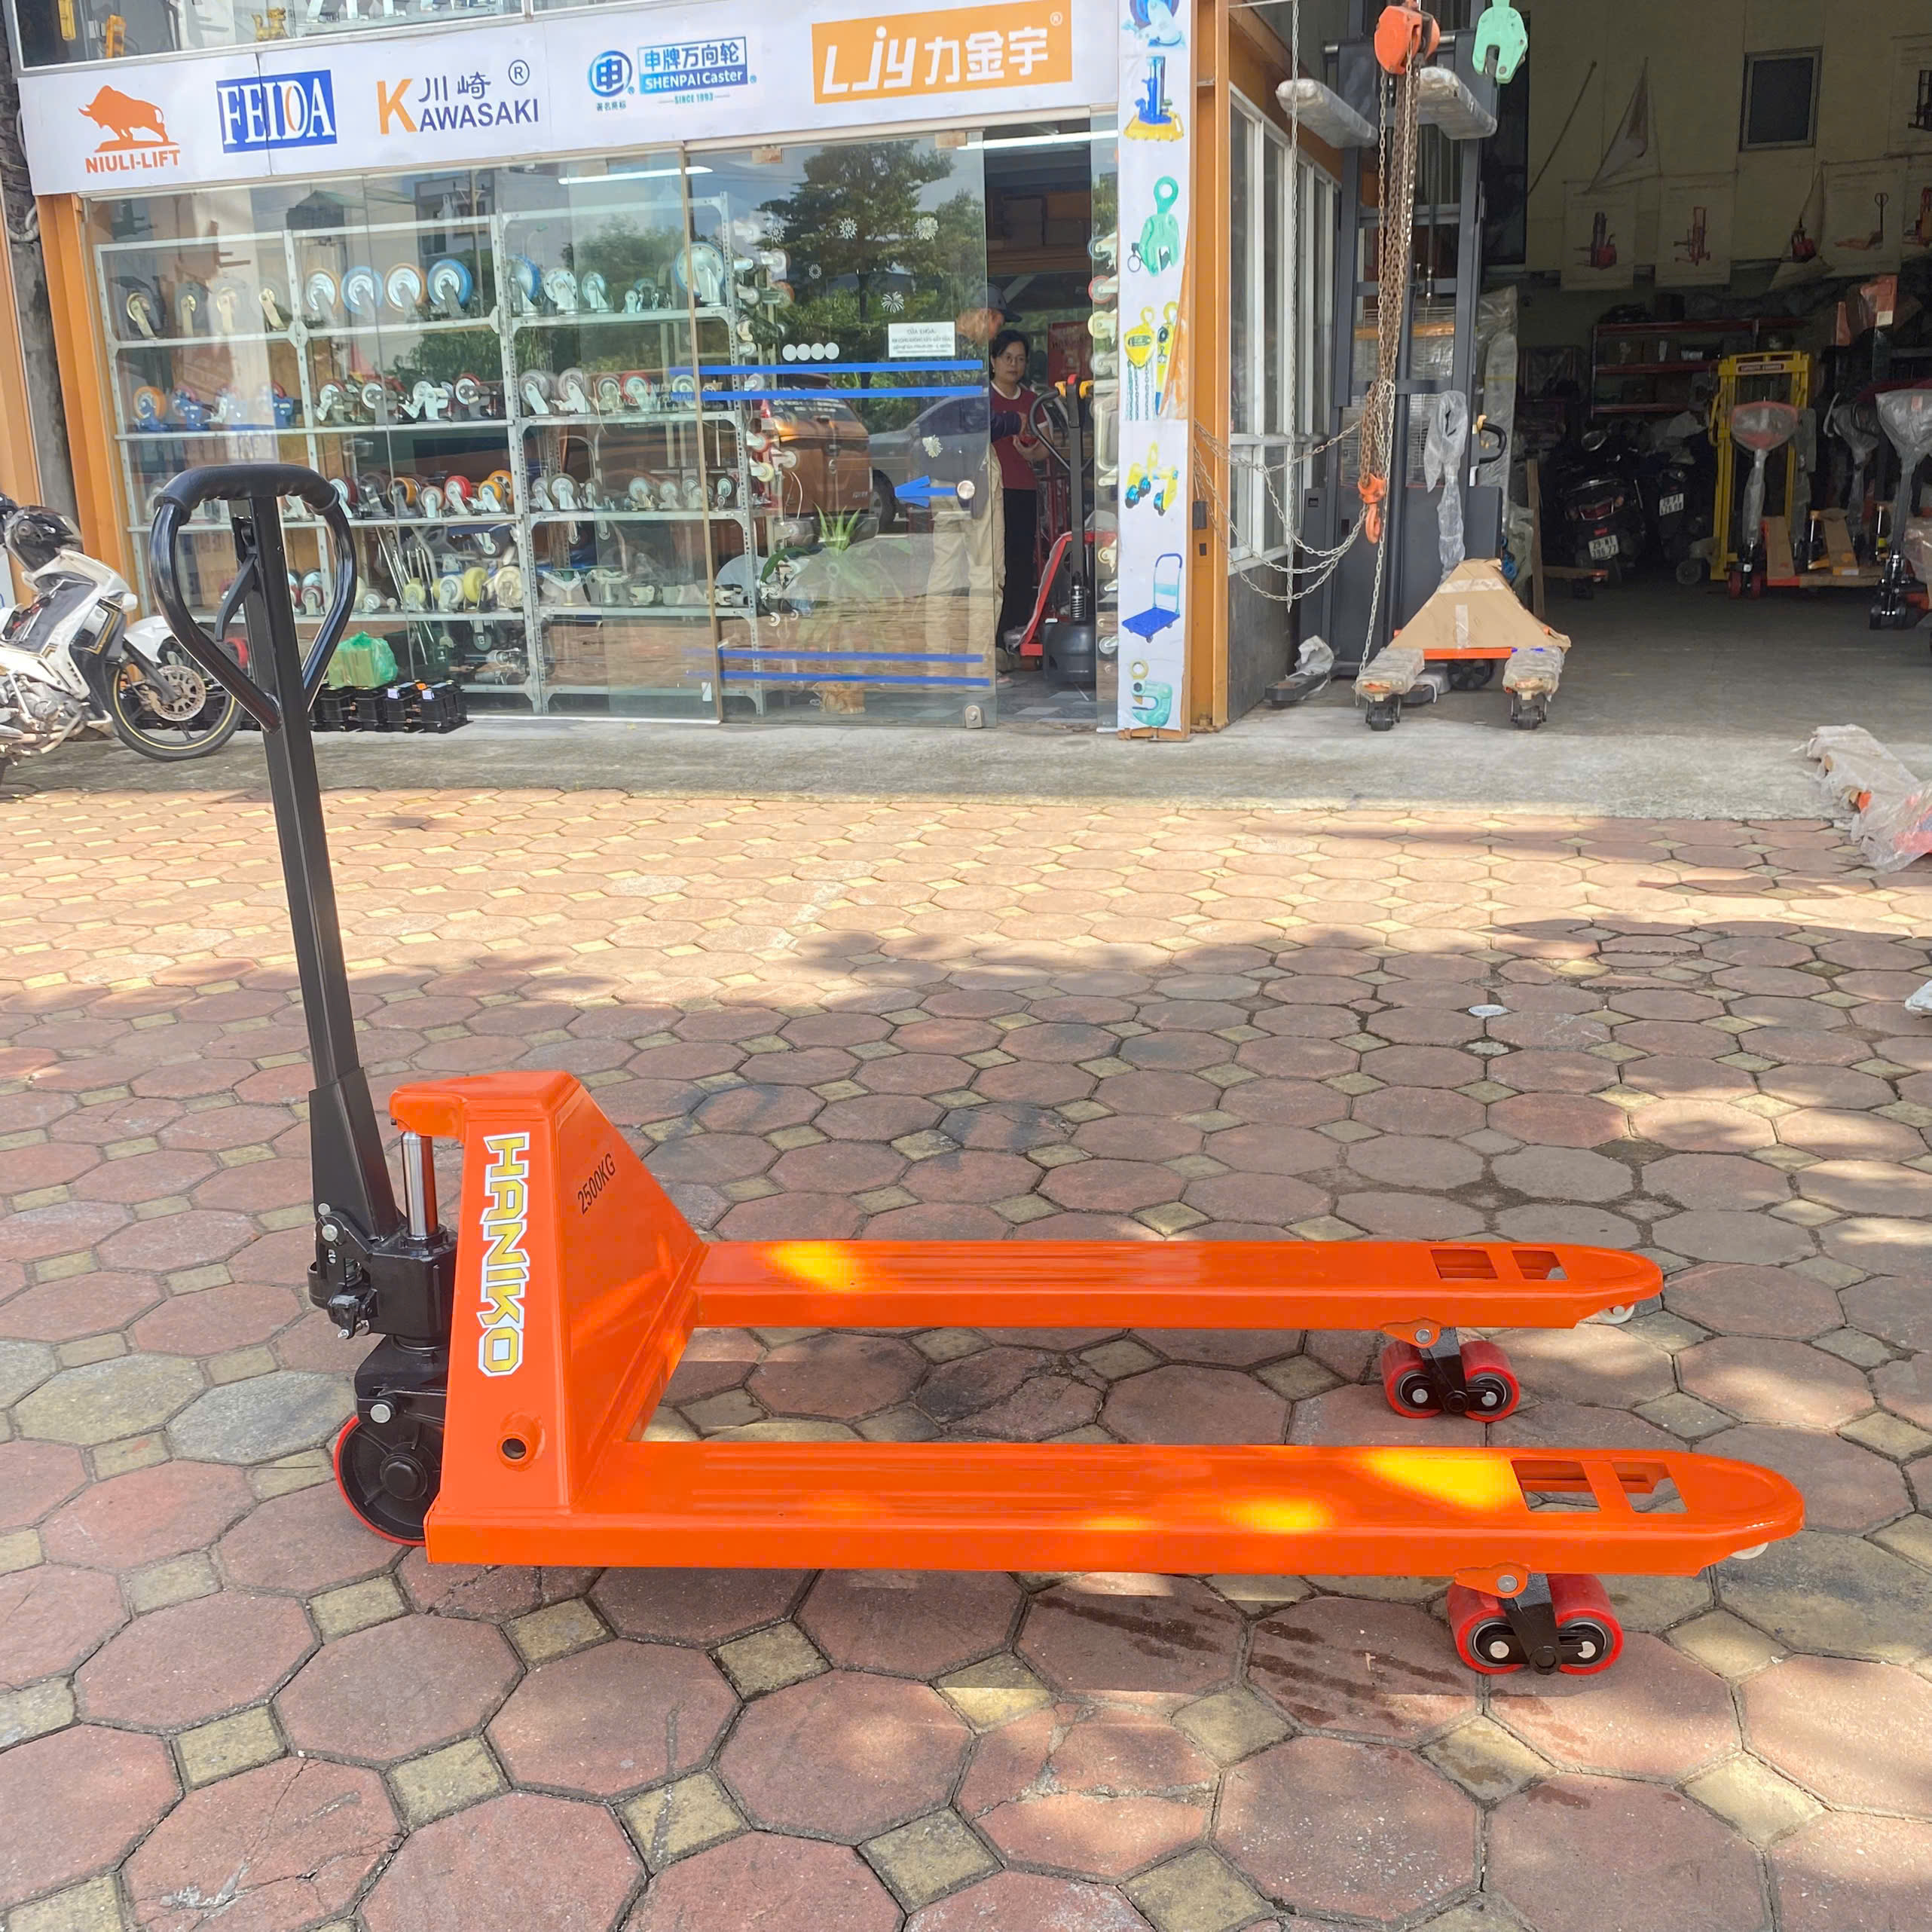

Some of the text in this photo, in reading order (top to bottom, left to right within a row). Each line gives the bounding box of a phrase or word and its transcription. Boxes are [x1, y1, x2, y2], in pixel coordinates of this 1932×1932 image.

[644, 41, 740, 72] 申牌万向轮
[924, 26, 1049, 86] 力金宇
[417, 71, 491, 103] 川崎
[645, 69, 743, 90] SHENPAI Caster
[674, 94, 695, 105] SINCE
[217, 78, 335, 146] FEIDA
[377, 78, 540, 136] KAWASAKI
[84, 150, 181, 174] NIULI-LIFT
[576, 1153, 616, 1215] 2500KG
[476, 1132, 530, 1377] HANIKO
